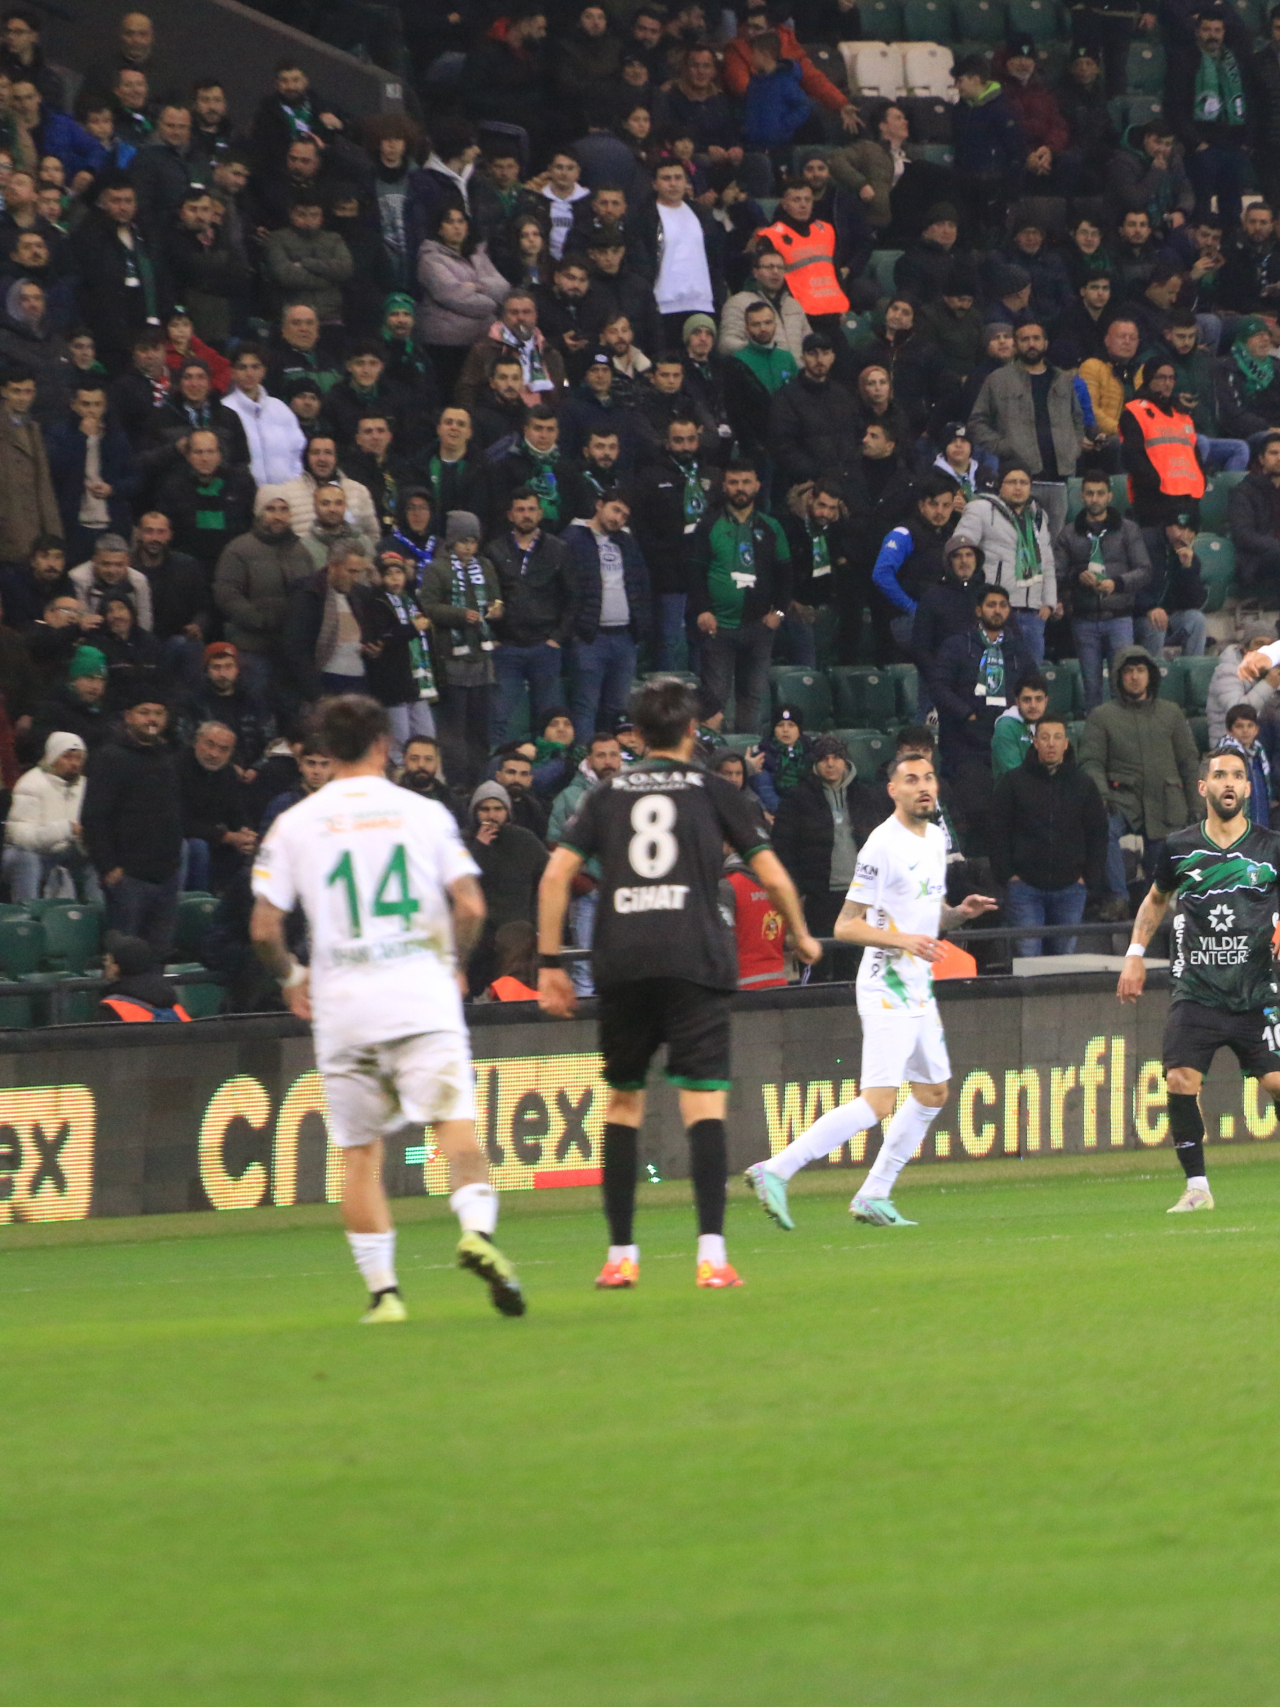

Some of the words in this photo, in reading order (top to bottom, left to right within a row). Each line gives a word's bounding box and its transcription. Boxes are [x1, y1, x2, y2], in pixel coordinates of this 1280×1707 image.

[628, 794, 679, 879] 8
[325, 843, 420, 938] 14
[1190, 949, 1251, 965] ENTEGR
[1199, 935, 1249, 951] YILDIZ
[470, 1062, 594, 1168] lex
